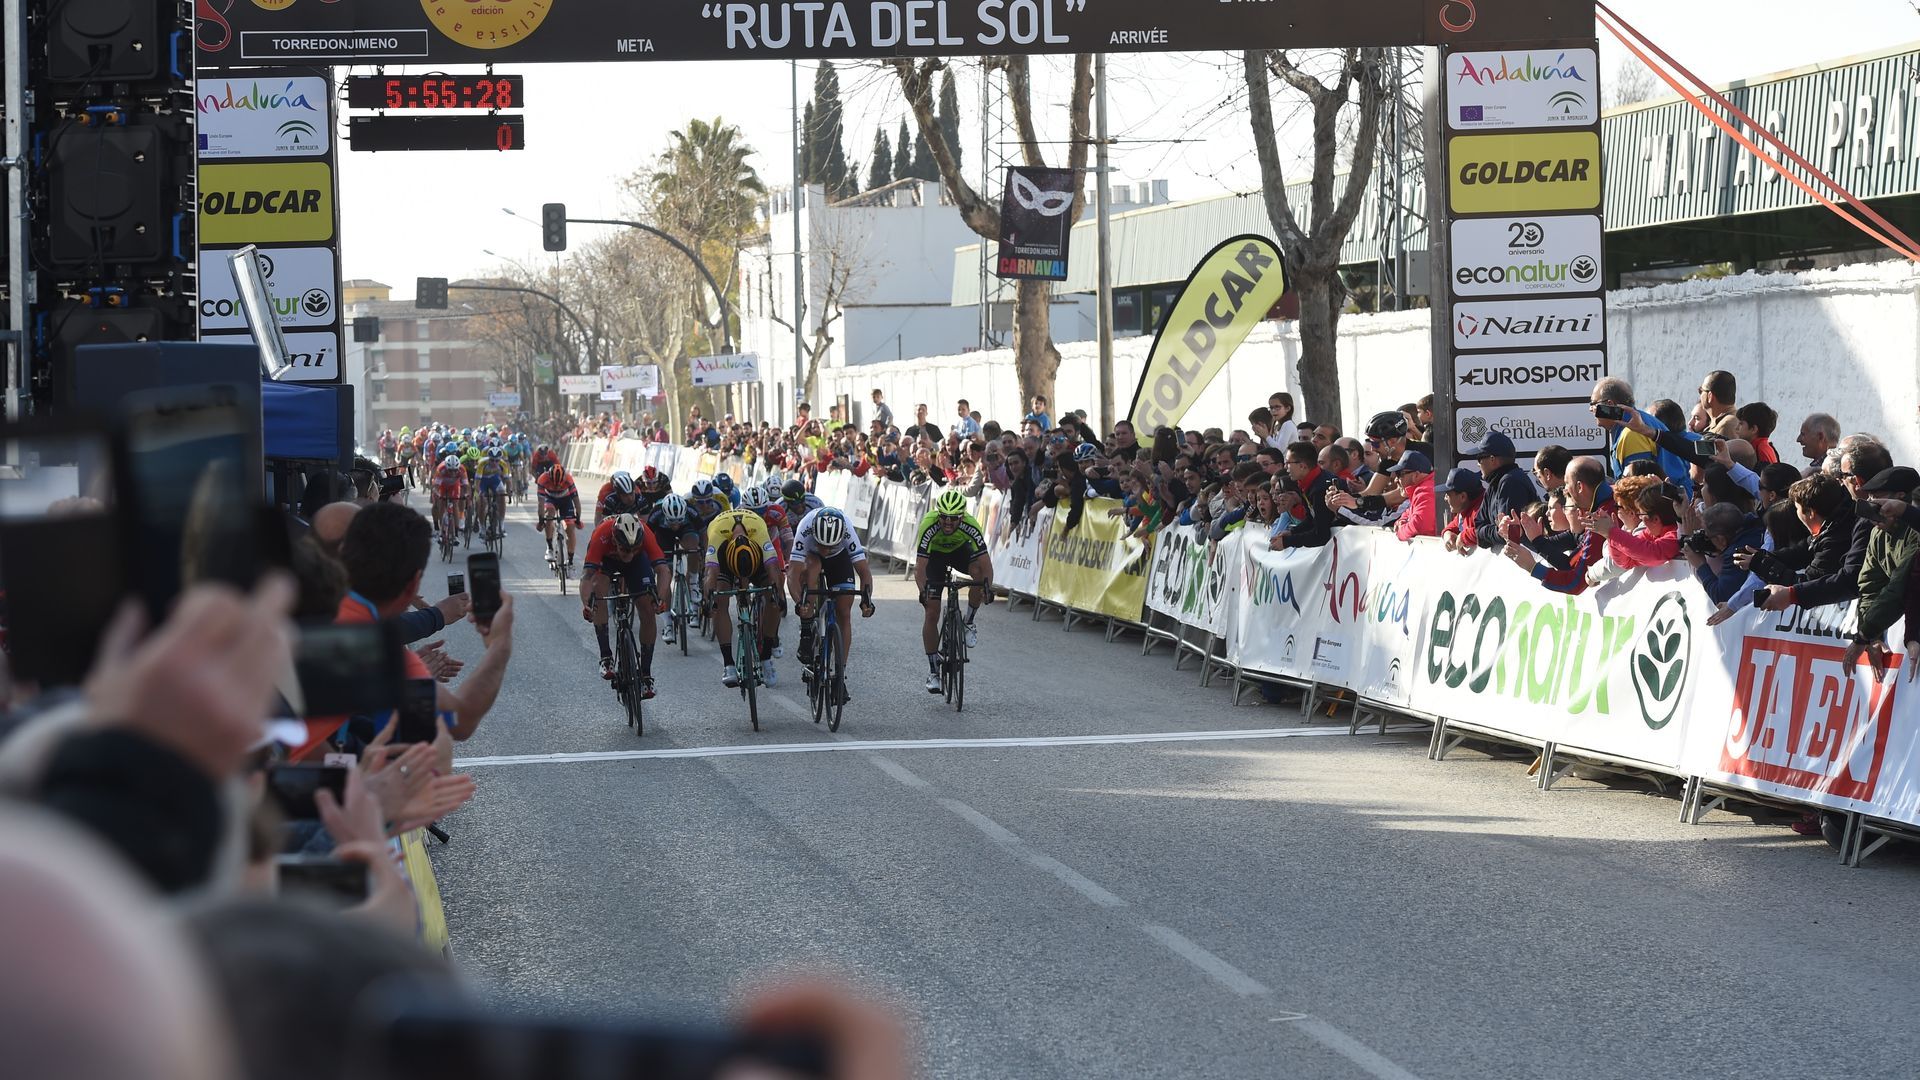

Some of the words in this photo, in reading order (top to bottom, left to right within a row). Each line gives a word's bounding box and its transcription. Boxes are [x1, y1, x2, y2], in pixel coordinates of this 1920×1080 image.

[471, 6, 504, 15] edición
[871, 1, 964, 47] DEL
[1109, 27, 1168, 45] ARRIVÉE
[272, 38, 398, 51] TORREDONJIMENO
[617, 39, 654, 53] META
[1456, 53, 1587, 86] Andalucía
[197, 81, 317, 113] ndalucía
[386, 80, 512, 108] 5:55:28
[497, 125, 512, 150] 0
[1825, 82, 1920, 174] PRA
[1459, 158, 1590, 185] GOLDCAR
[1000, 257, 1067, 277] CARNAVAL
[1456, 260, 1568, 285] econatur
[1482, 313, 1593, 336] Nalini
[1137, 242, 1274, 438] GOLDCAR
[1472, 364, 1601, 386] EUROSPORT
[1490, 422, 1547, 440] Senda
[1555, 425, 1602, 441] Málaga
[1500, 416, 1531, 428] Gran
[920, 522, 941, 549] MURIA
[960, 523, 985, 547] MURIAS
[1428, 588, 1635, 715] econatur
